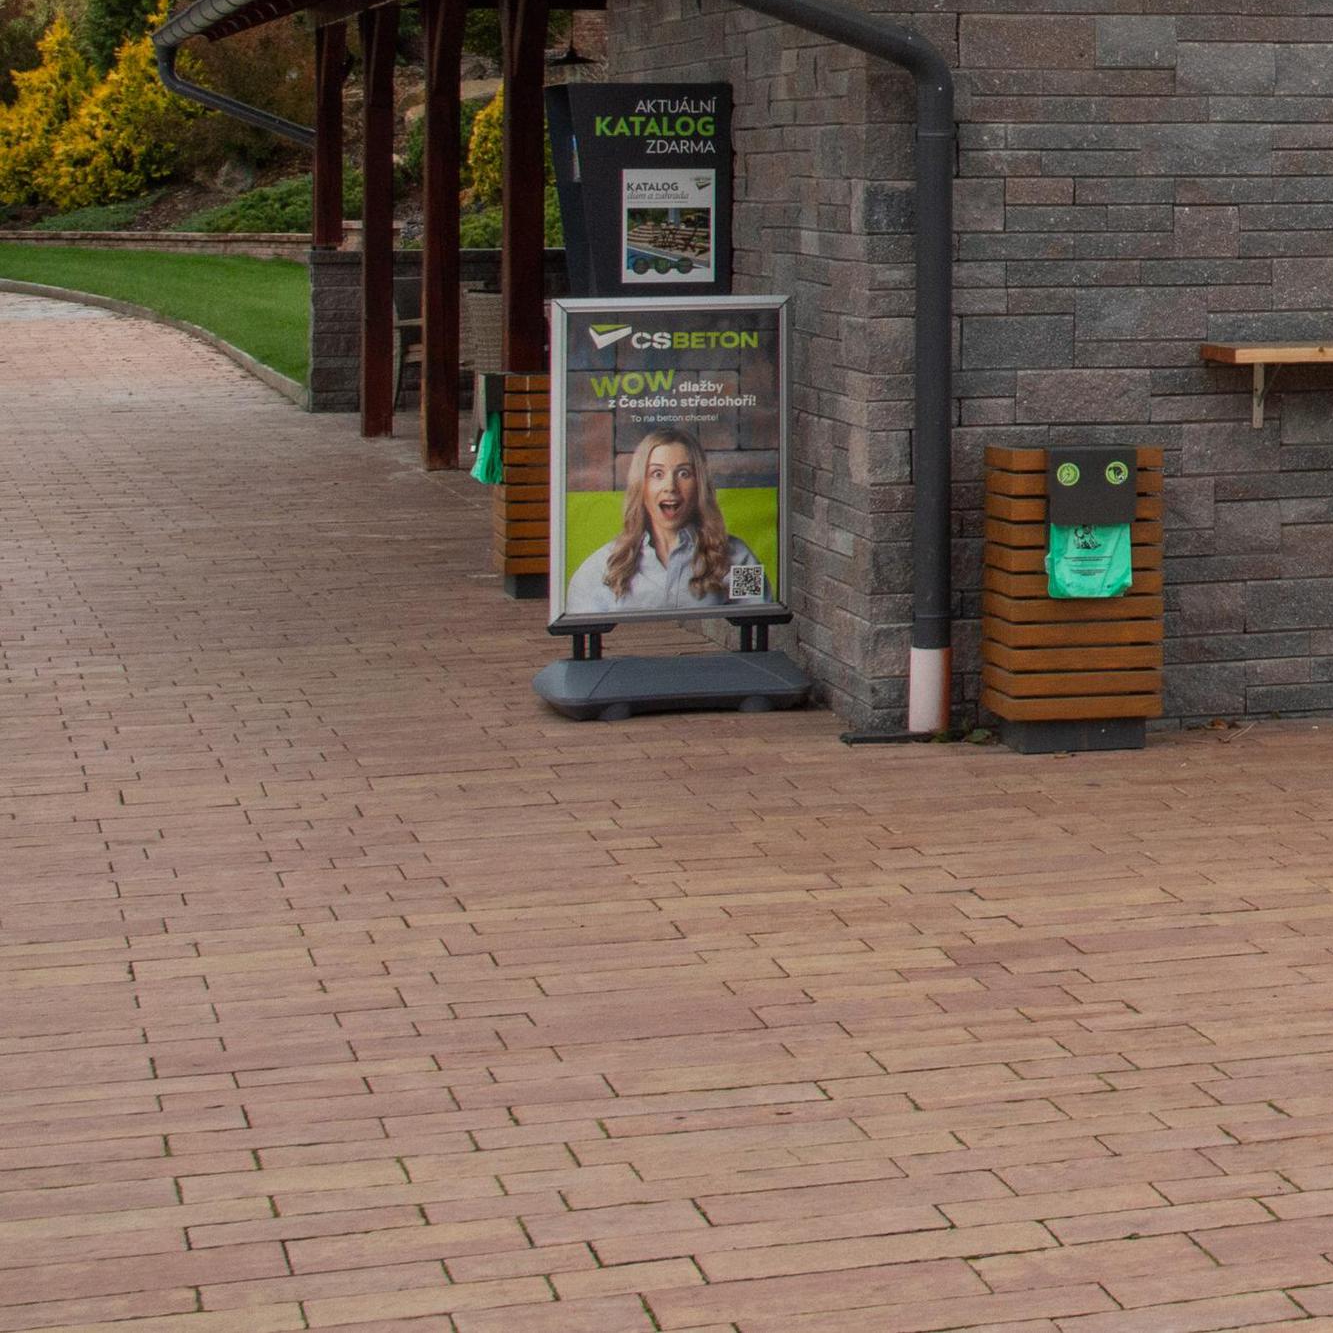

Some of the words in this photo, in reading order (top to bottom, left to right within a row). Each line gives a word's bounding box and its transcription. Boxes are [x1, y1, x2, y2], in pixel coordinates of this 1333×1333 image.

[635, 97, 717, 113] AKTUÁLNÍ
[595, 116, 715, 136] KATALOG
[646, 140, 716, 154] ZDARMA
[627, 182, 679, 191] KATALOG
[631, 331, 758, 349] CSBETON
[679, 379, 724, 394] dlažby
[608, 399, 616, 408] z
[619, 395, 678, 408] Českého
[680, 395, 757, 407] středohoří!
[631, 414, 641, 422] To
[656, 414, 684, 422] beton
